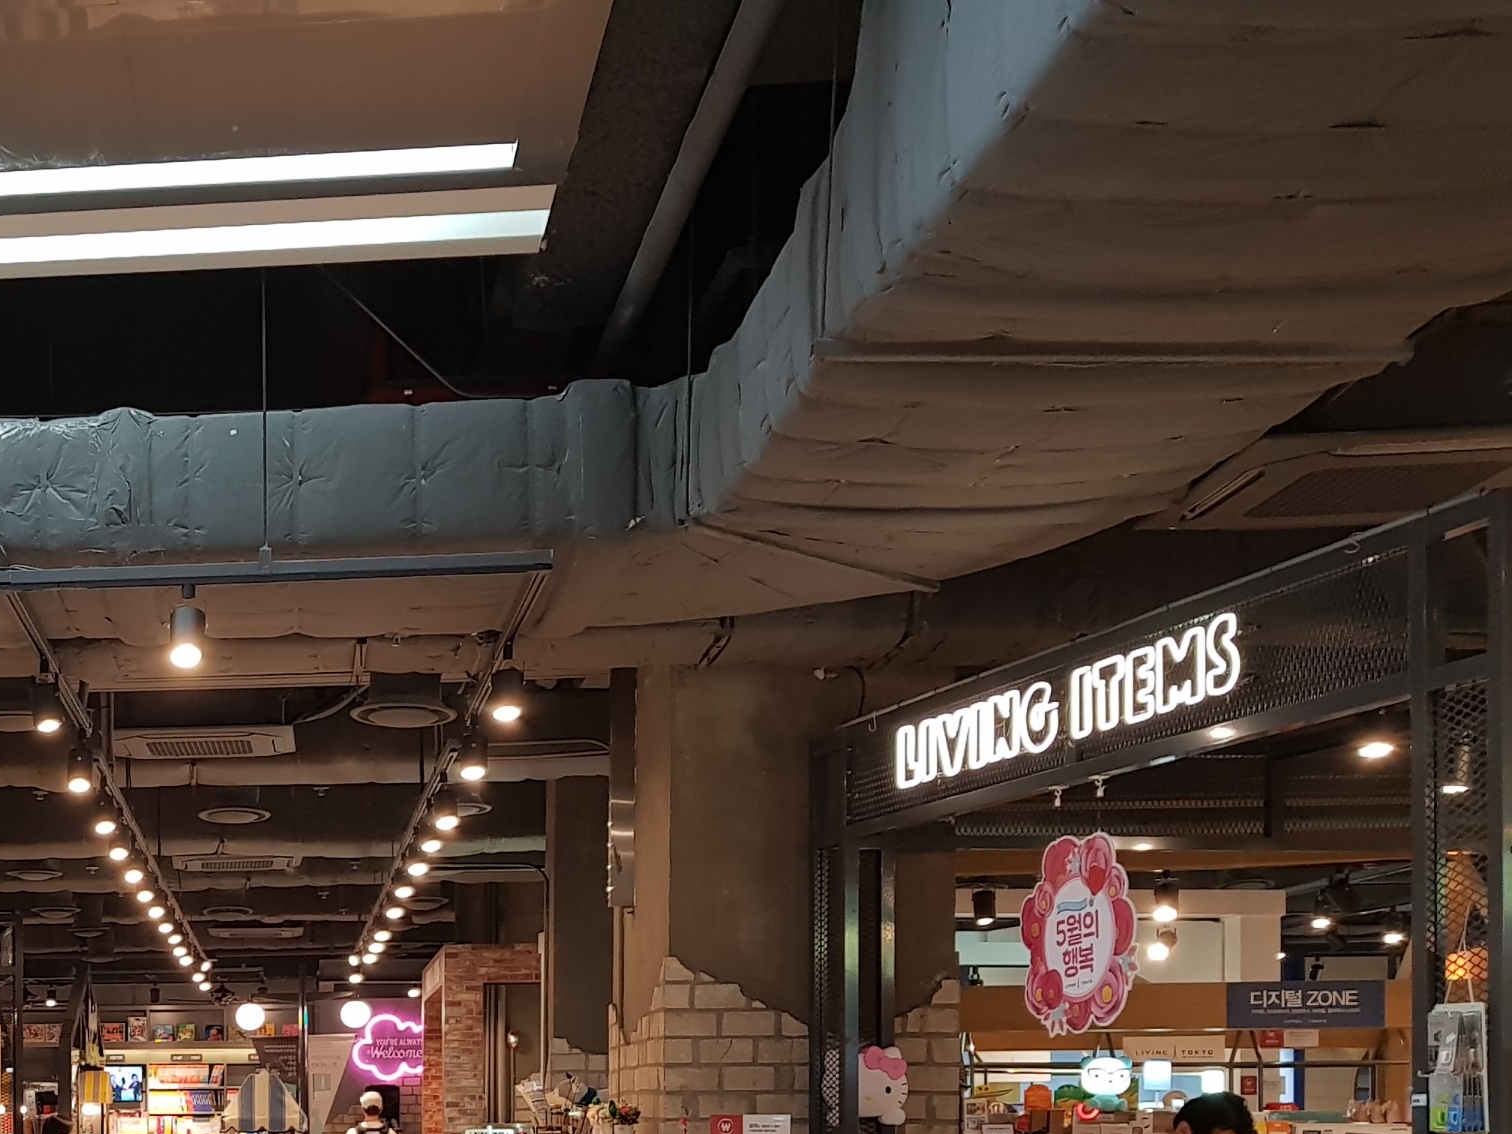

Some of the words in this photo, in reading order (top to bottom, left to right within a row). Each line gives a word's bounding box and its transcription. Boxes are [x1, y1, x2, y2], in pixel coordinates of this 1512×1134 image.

[895, 681, 1060, 790] LIVING
[1068, 611, 1241, 740] ITEMS
[1056, 908, 1099, 947] 5월의
[1062, 943, 1095, 979] 행복
[1250, 989, 1303, 1008] 디지털
[1307, 989, 1359, 1007] ZONE
[399, 1038, 422, 1046] ALWAY
[371, 1046, 423, 1059] Welcome
[1135, 1049, 1168, 1057] LIVING
[1181, 1049, 1214, 1057] TOKYO
